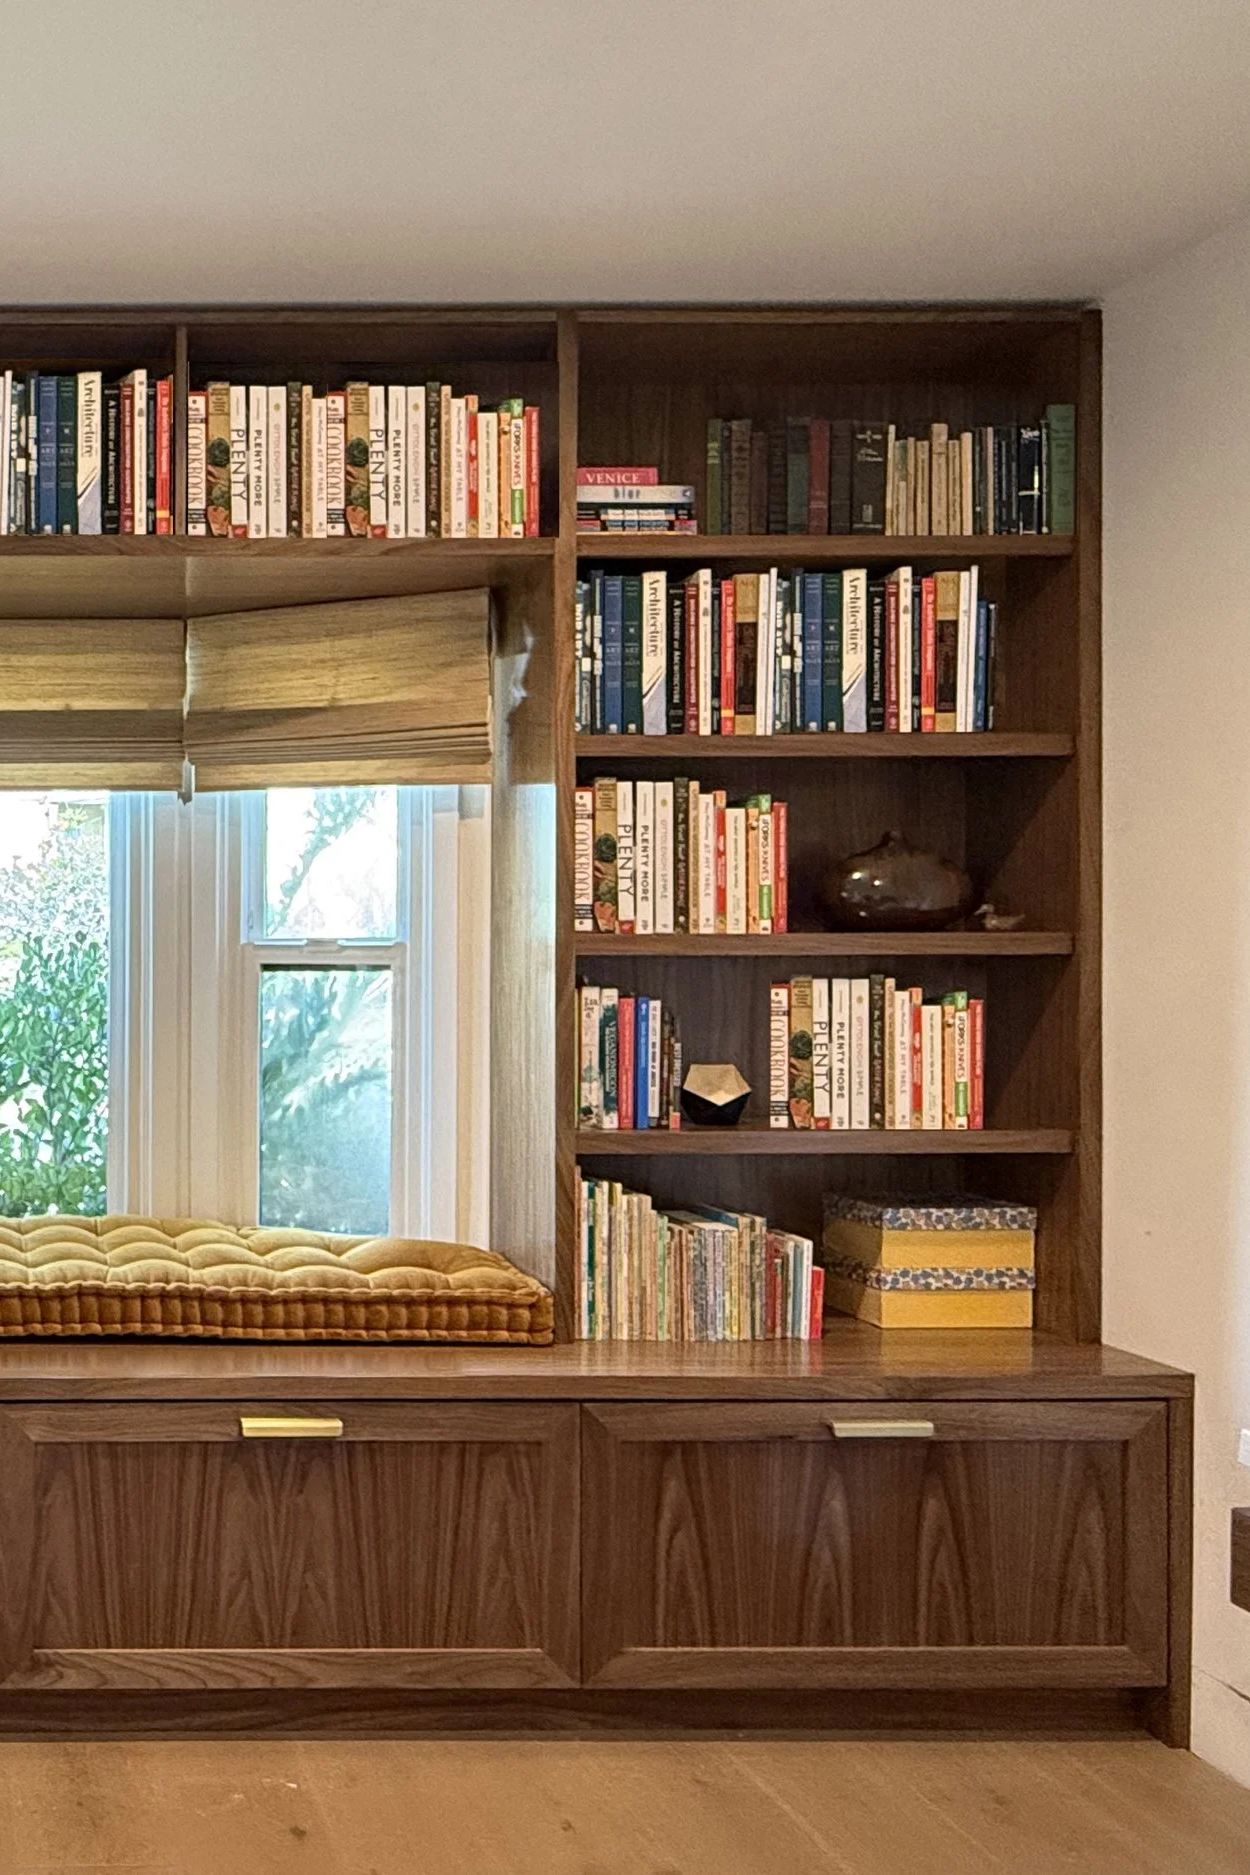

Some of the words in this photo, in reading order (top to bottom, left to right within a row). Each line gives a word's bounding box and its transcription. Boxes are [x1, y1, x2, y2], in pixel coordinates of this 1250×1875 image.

[84, 379, 98, 457] Architecture
[393, 430, 401, 471] PLENTY
[188, 427, 202, 504] COOKBOOK
[231, 429, 246, 500] PLENTY
[327, 427, 342, 504] COOKBOOK
[370, 429, 385, 500] PLENTY
[393, 476, 401, 506] MORE
[586, 473, 641, 484] VENICE
[648, 578, 662, 657] Architecture
[848, 576, 862, 654] Architecture
[575, 823, 590, 900] COOKBOOK
[618, 824, 633, 896] PLENTY
[641, 825, 649, 867] PLENTY
[641, 871, 649, 902] MORE
[609, 1021, 617, 1097] VEGANOMICON
[771, 1019, 786, 1097] COOKBOOK
[814, 1021, 829, 1093] PLENTY
[837, 1022, 845, 1064] PLENTY
[837, 1068, 845, 1099] MORE
